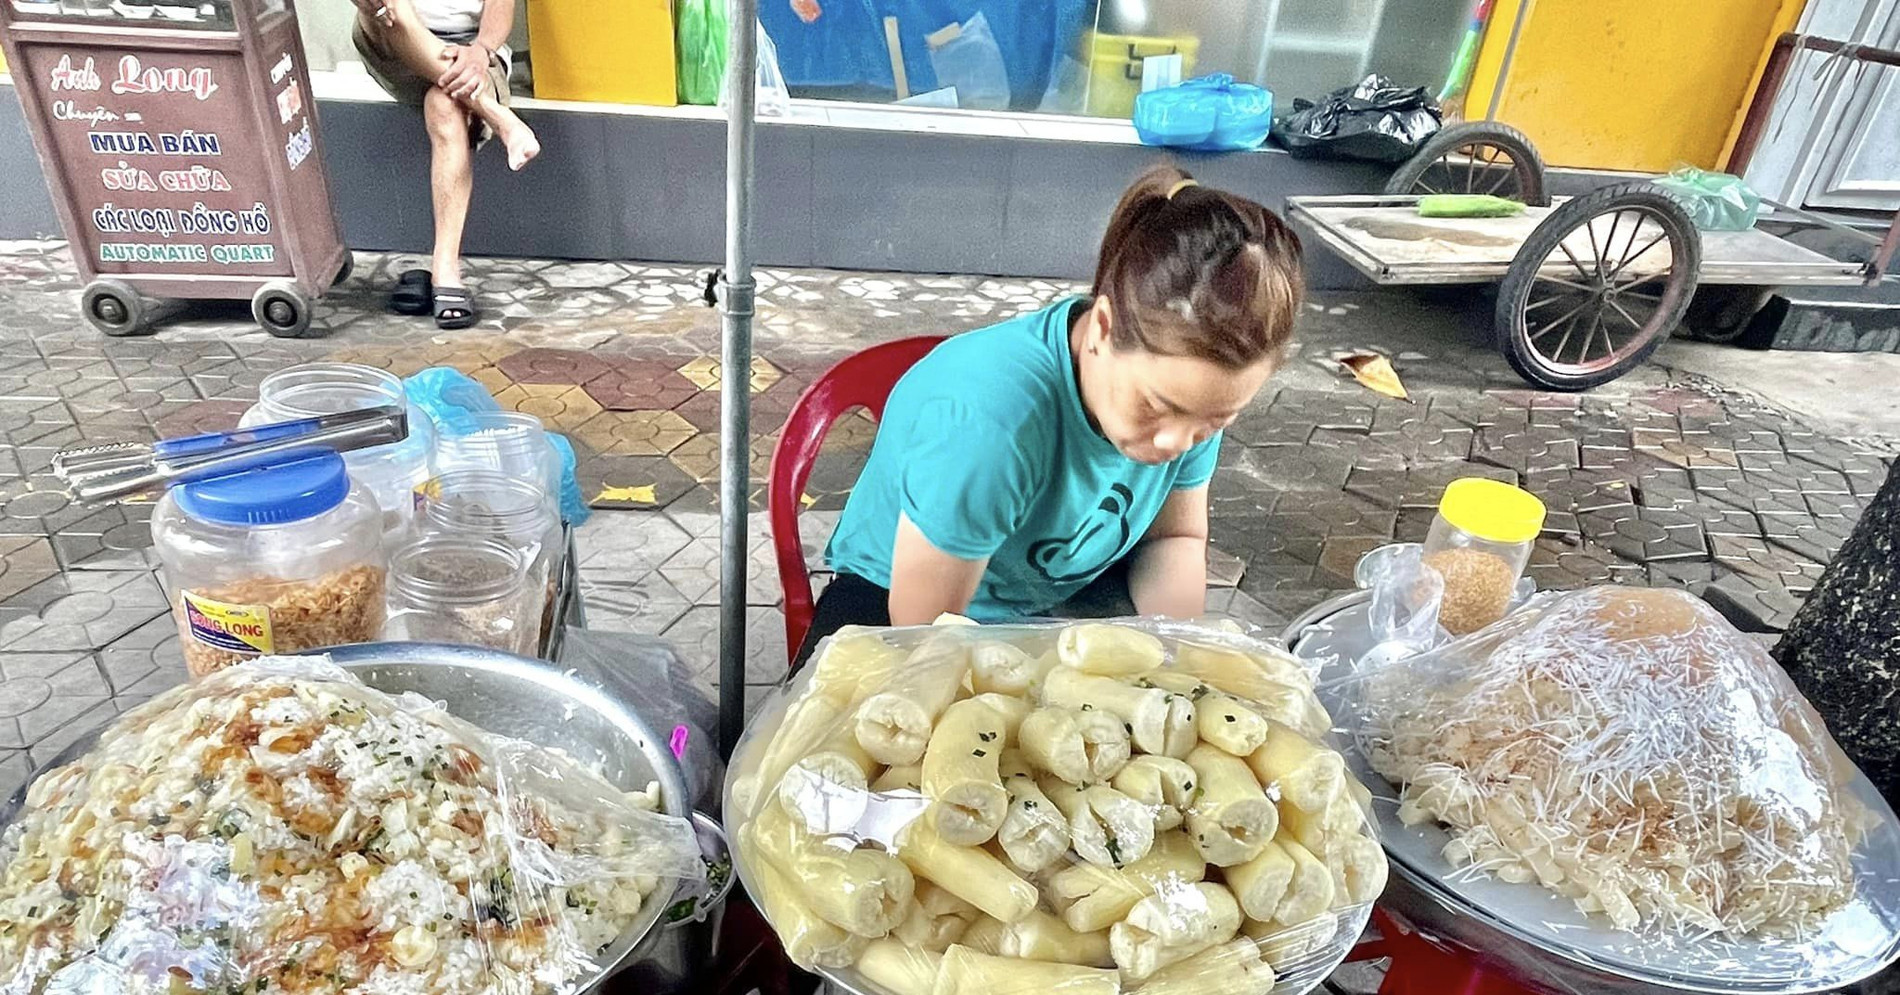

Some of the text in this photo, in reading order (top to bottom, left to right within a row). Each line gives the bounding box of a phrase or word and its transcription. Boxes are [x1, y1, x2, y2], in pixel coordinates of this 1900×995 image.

[51, 54, 219, 100] Anh Long
[53, 101, 119, 127] Chuyên
[89, 130, 221, 155] MUA BÁN
[101, 161, 231, 191] SỬA CHỮA
[130, 209, 176, 237] LOẠI
[179, 202, 239, 234] ĐỒNG
[239, 202, 271, 234] HỒ
[101, 244, 274, 264] AUTOMATIC QUART
[224, 622, 264, 637] LONG
